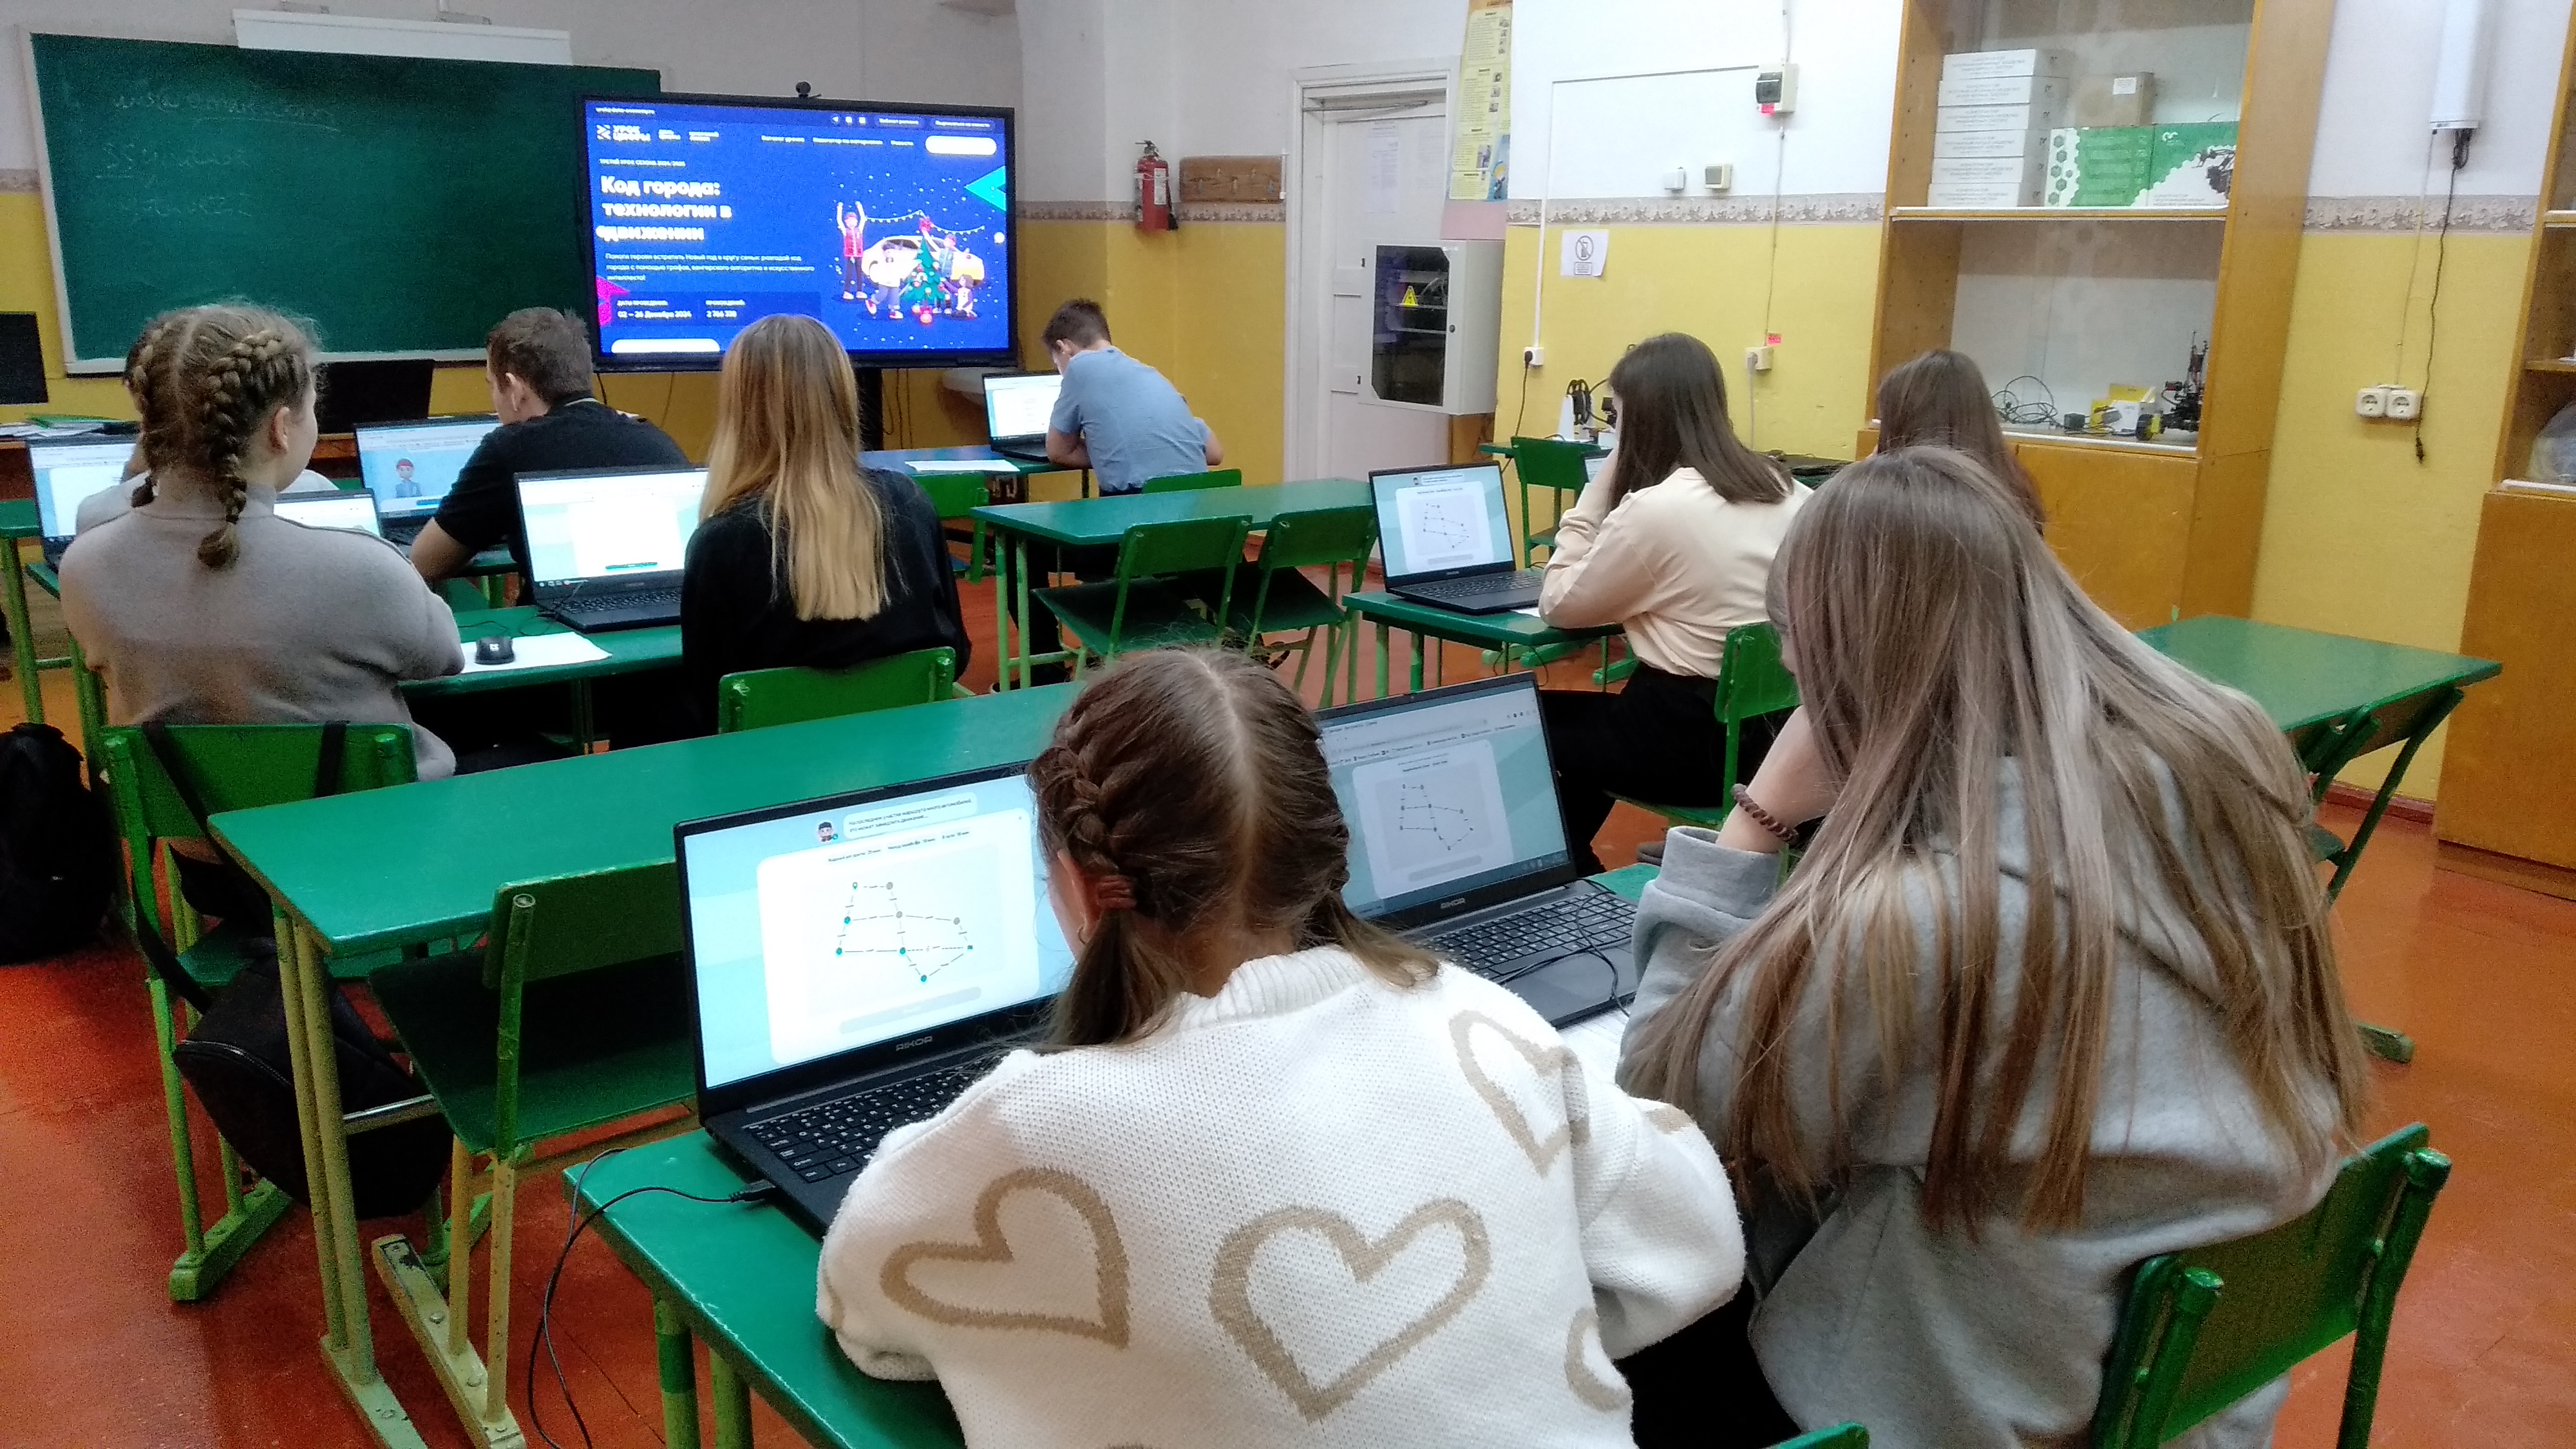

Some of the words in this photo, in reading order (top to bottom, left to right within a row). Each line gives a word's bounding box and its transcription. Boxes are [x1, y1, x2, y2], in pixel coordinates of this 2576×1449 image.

[601, 175, 641, 197] Код
[643, 180, 721, 198] города:
[601, 203, 717, 218] технологии
[719, 205, 732, 218] в
[895, 1036, 934, 1052] RIKOR
